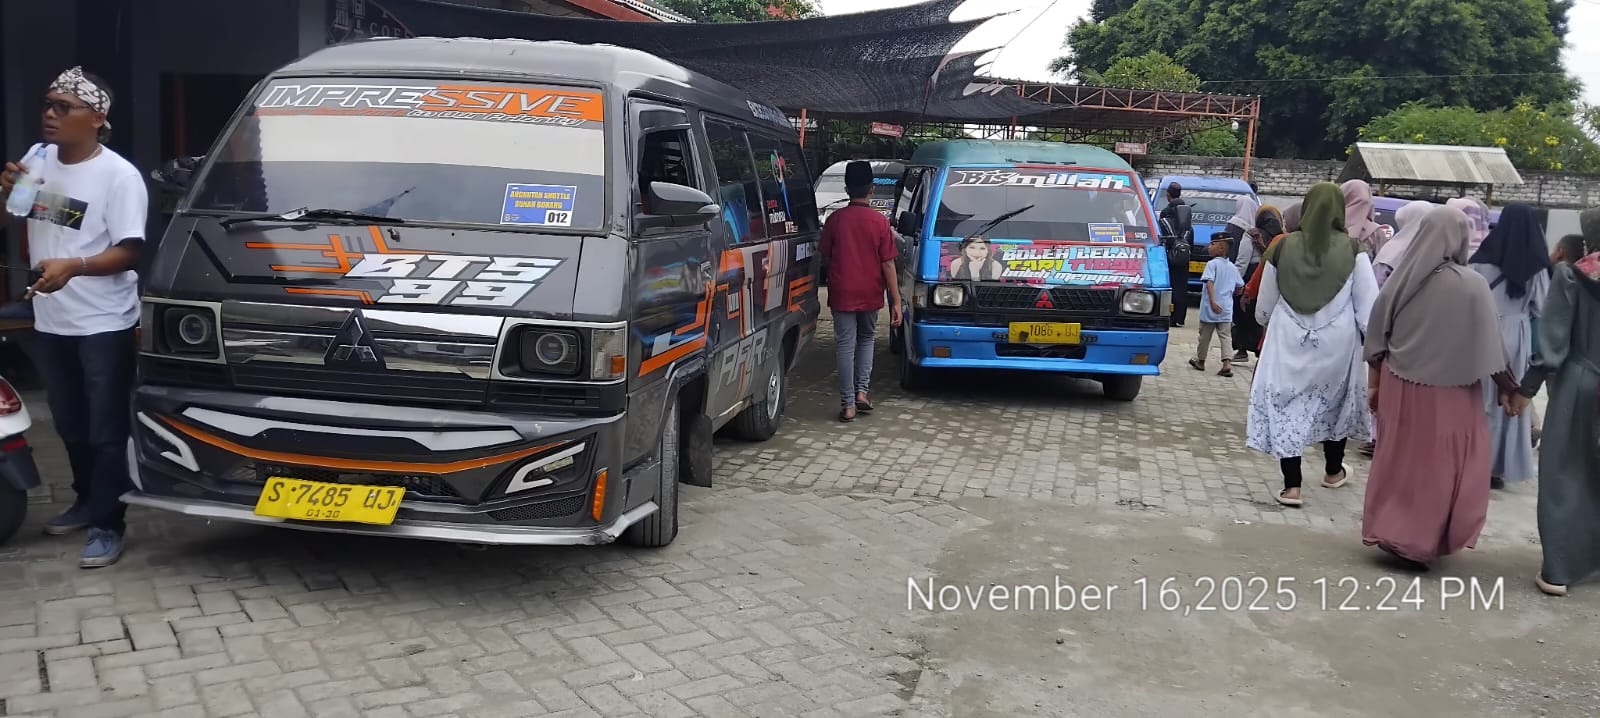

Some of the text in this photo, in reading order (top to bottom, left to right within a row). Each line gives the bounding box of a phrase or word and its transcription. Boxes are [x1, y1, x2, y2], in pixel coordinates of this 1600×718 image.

[259, 85, 591, 115] IMPRESSIVE
[484, 112, 587, 127] Priority
[547, 212, 568, 223] 012
[1003, 247, 1069, 261] BOLEH
[1076, 246, 1144, 260] LELAH
[345, 253, 564, 282] BTS
[376, 278, 538, 307] 99
[268, 482, 285, 502] S
[295, 484, 352, 508] 7485
